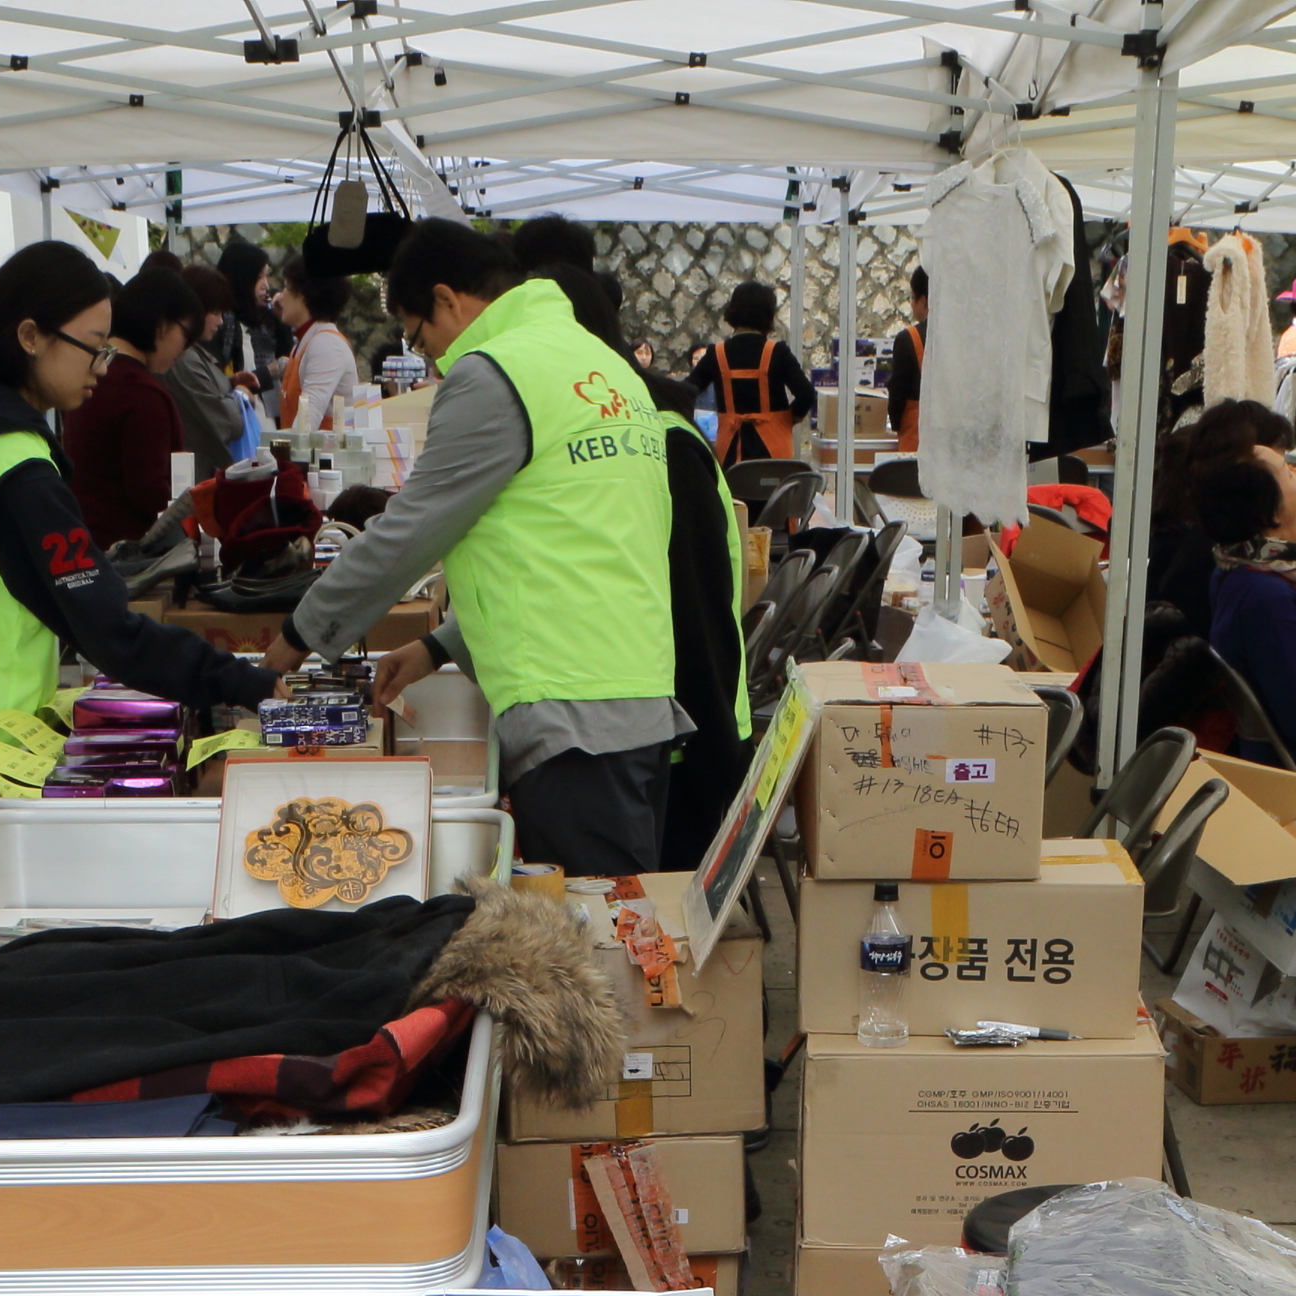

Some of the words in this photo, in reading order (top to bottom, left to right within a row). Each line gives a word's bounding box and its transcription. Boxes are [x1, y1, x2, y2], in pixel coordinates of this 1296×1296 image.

[567, 435, 618, 465] KEB
[42, 527, 95, 575] 22
[954, 763, 989, 781] 출고
[908, 934, 989, 982] 장품
[1004, 937, 1075, 984] 전용
[917, 1100, 949, 1109] OHSAS
[955, 1165, 1027, 1179] COSMAX
